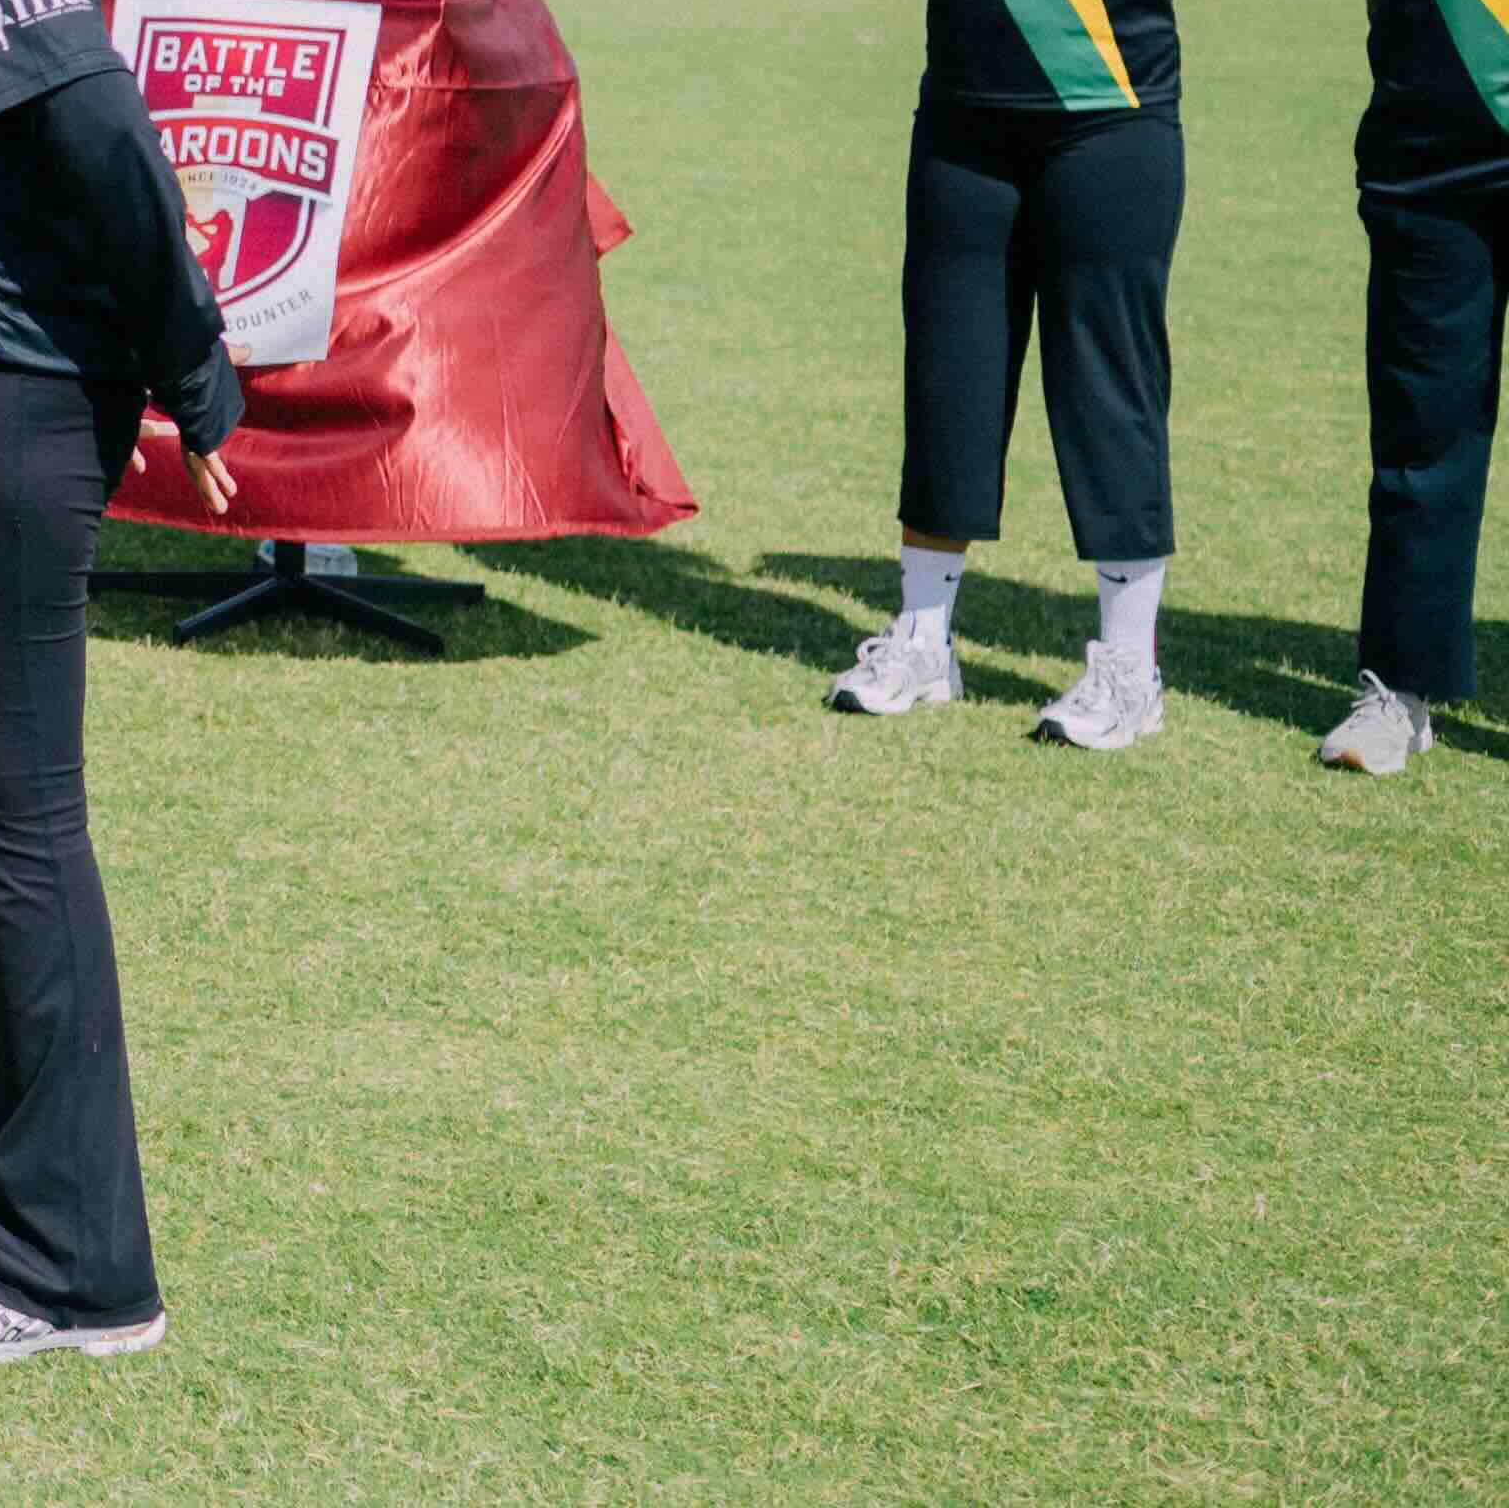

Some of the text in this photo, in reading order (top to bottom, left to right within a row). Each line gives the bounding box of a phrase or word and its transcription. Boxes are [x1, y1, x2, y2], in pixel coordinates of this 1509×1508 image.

[154, 35, 320, 81] BATTLE
[183, 73, 286, 98] OF THE
